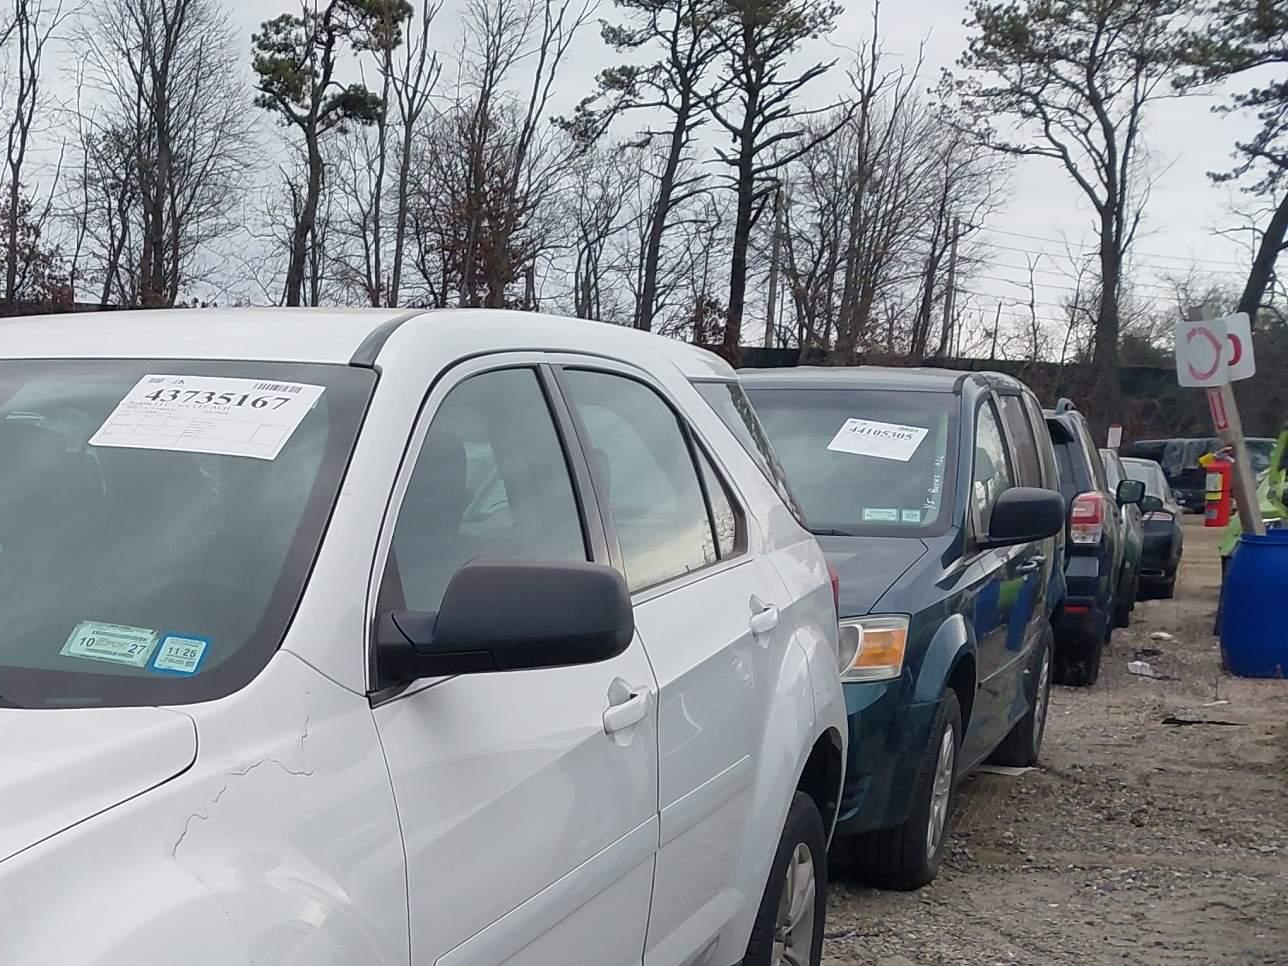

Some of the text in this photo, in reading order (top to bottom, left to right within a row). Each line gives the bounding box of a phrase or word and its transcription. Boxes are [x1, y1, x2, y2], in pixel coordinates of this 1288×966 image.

[145, 387, 291, 411] 43735167
[848, 425, 915, 441] 44105305
[79, 637, 96, 648] 10
[127, 643, 147, 655] 27
